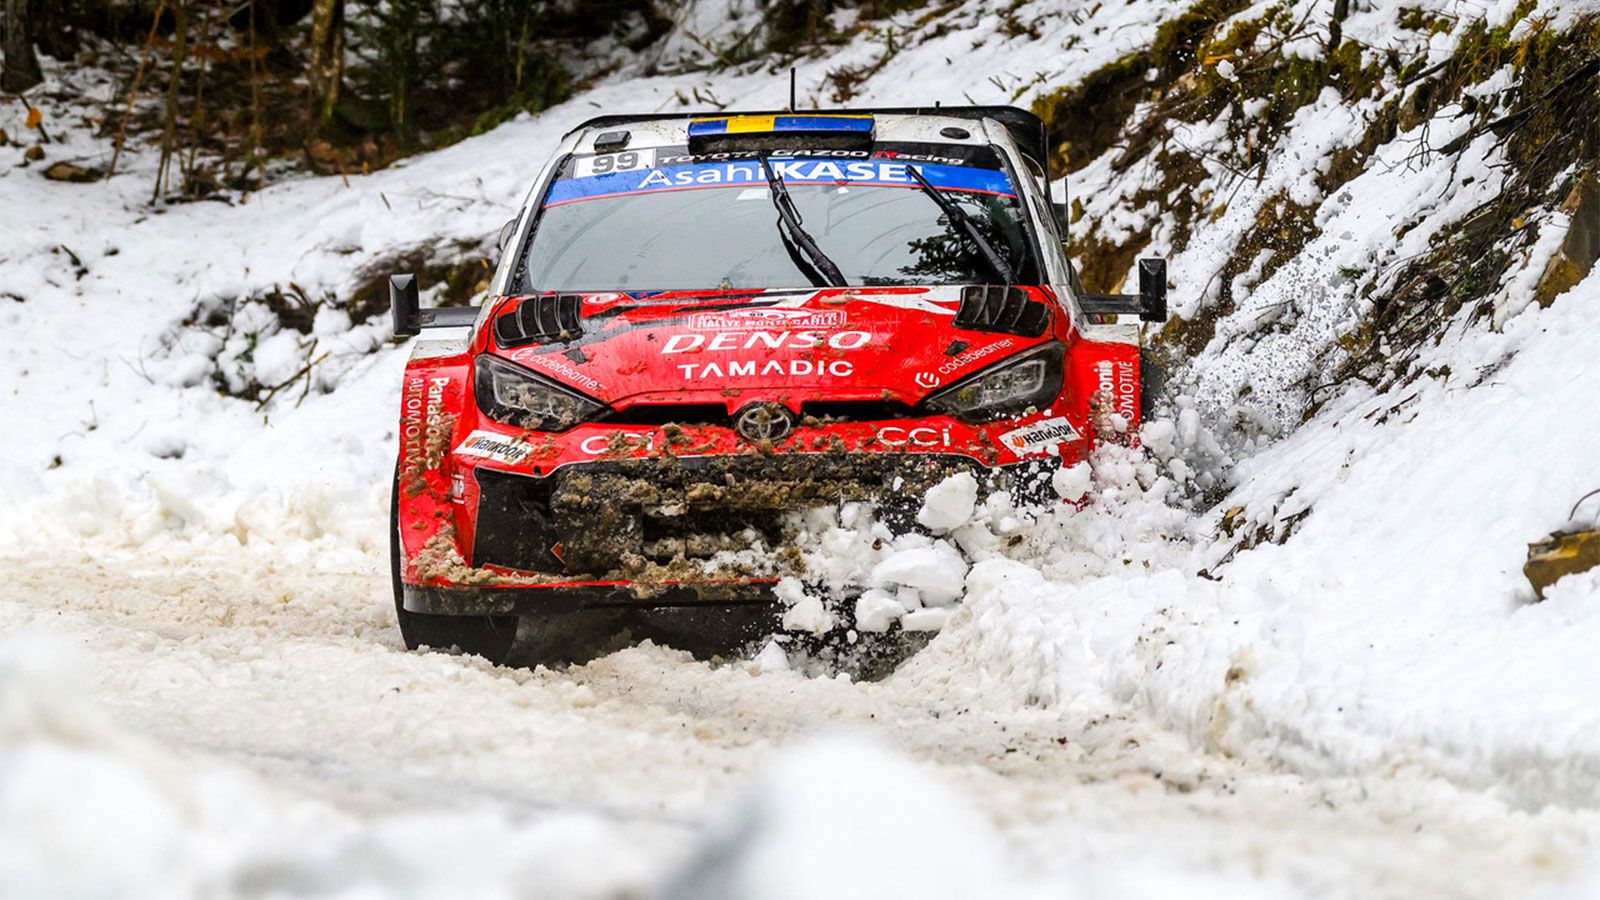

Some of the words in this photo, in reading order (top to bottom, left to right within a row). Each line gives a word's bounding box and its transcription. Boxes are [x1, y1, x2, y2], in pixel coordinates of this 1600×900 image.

[592, 152, 639, 174] 99
[659, 151, 761, 164] TOYOTA
[771, 149, 869, 157] GAZOO
[874, 150, 964, 165] Racing
[660, 330, 872, 354] DENSO
[938, 338, 1014, 375] codebeamer
[677, 360, 854, 380] TAMADIC
[426, 377, 450, 470] Panasoc
